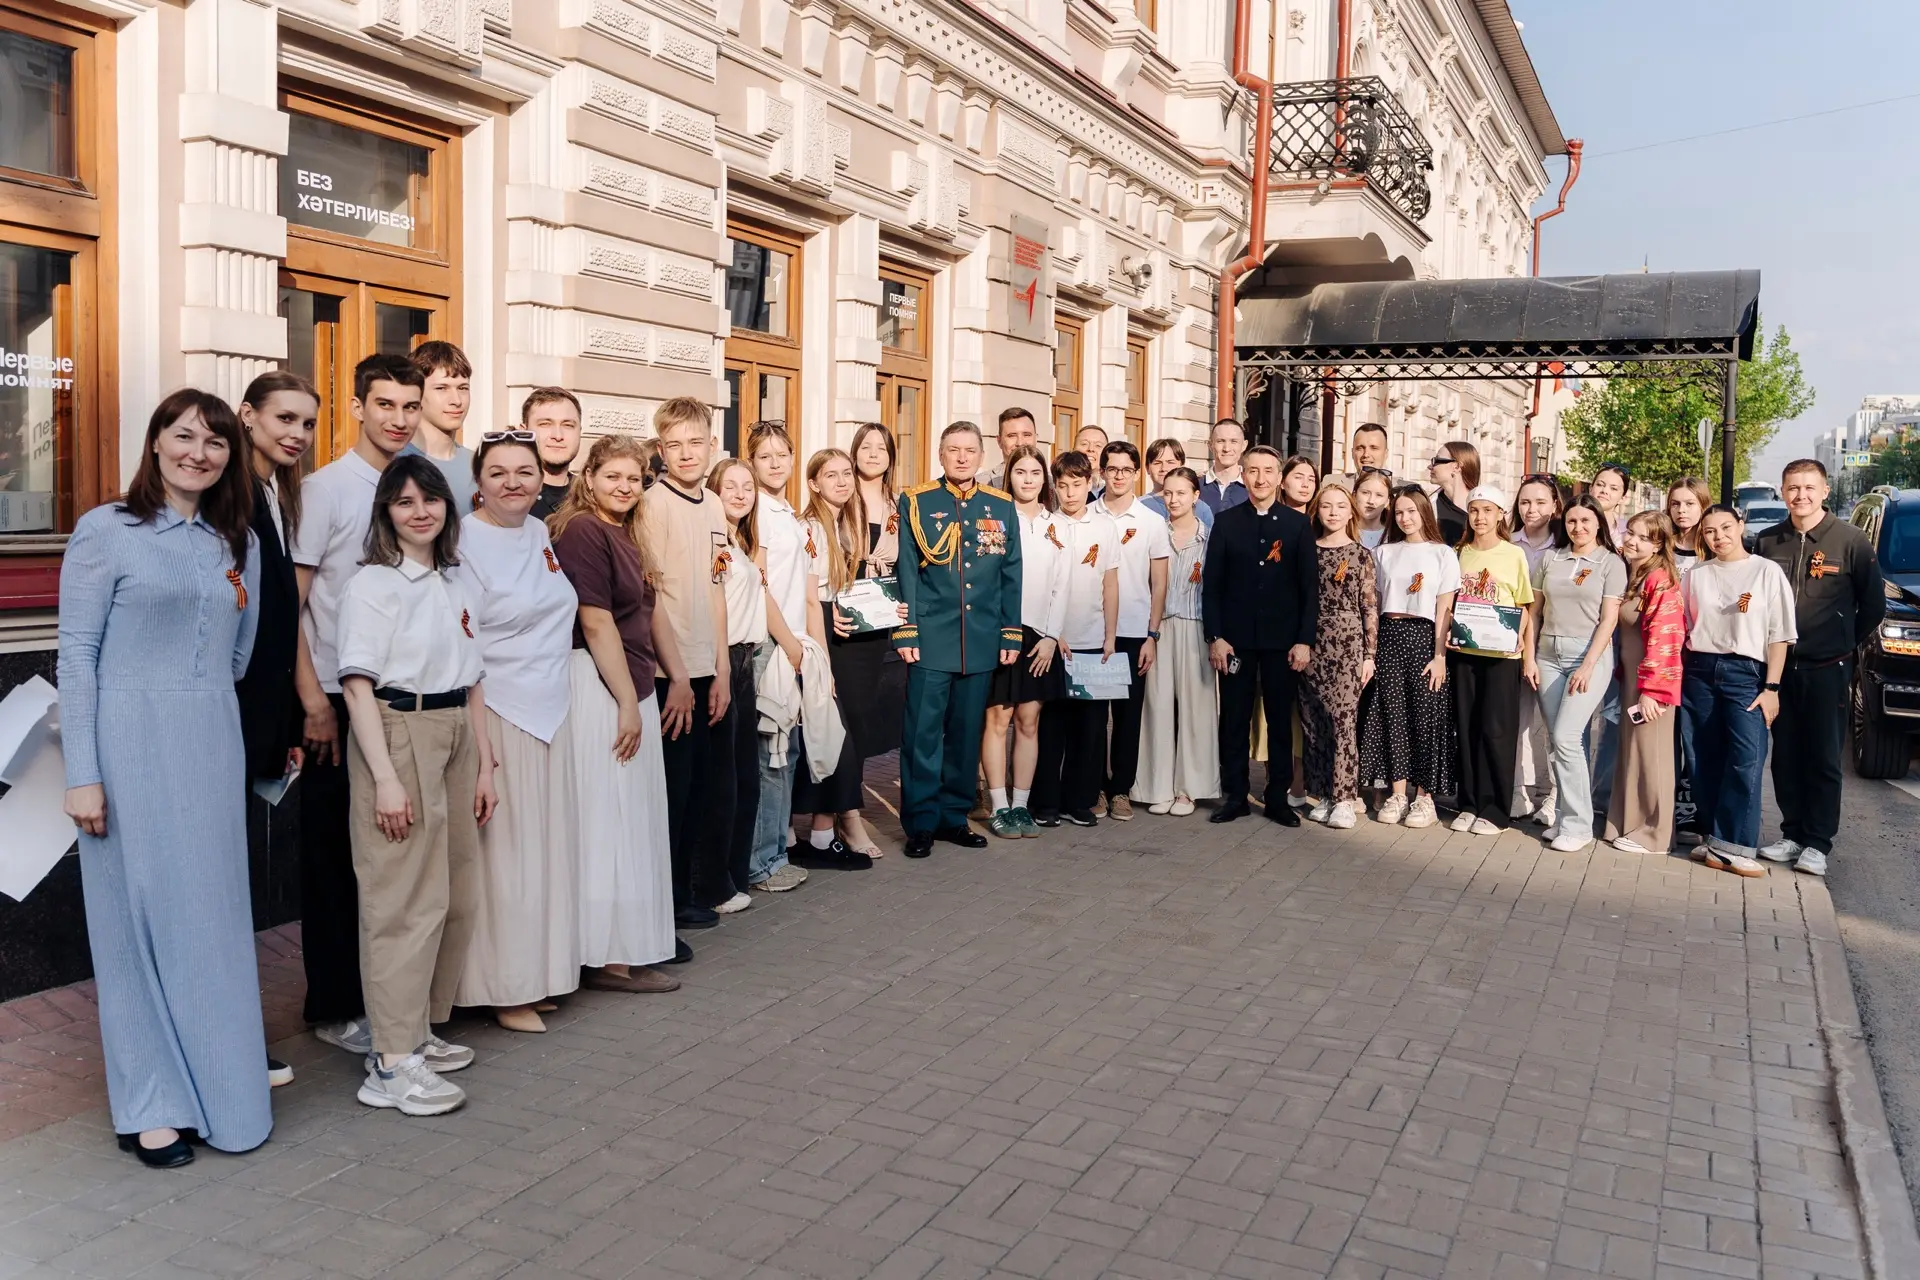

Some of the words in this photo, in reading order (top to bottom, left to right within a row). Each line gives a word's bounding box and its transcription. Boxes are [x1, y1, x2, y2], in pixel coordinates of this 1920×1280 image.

[297, 169, 333, 191] БЕЗ
[297, 193, 415, 231] ХӘТЕРЛИБЕЗ!
[889, 292, 917, 308] ПЕРВЫЕ
[889, 306, 917, 320] ПОМНЯТ
[0, 373, 74, 390] омнят
